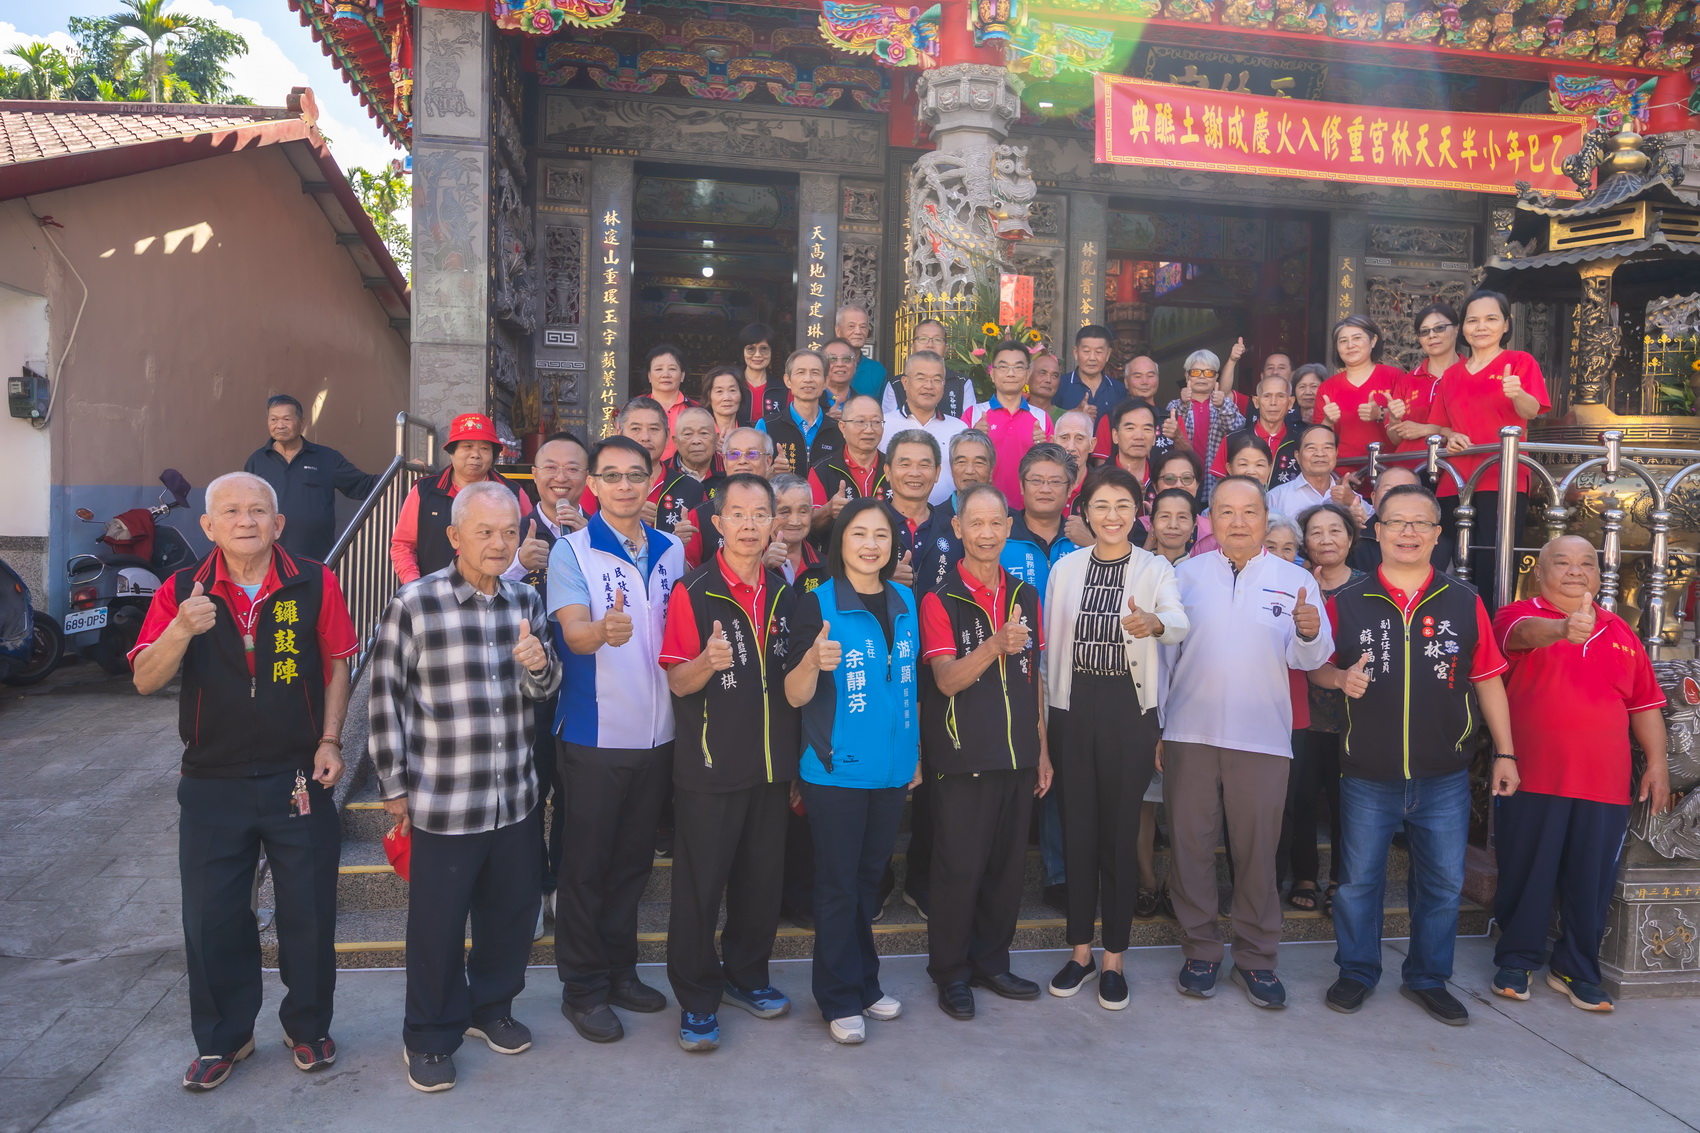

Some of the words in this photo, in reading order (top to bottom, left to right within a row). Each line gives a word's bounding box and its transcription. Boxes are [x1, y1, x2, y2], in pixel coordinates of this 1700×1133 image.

[1025, 552, 1036, 586] 服務處主
[272, 599, 300, 685] 鑼鼓陣
[865, 639, 876, 658] 主任
[1380, 619, 1391, 674] 副主任委員
[1424, 619, 1458, 680] 天林宮
[845, 648, 867, 714] 余靜芬
